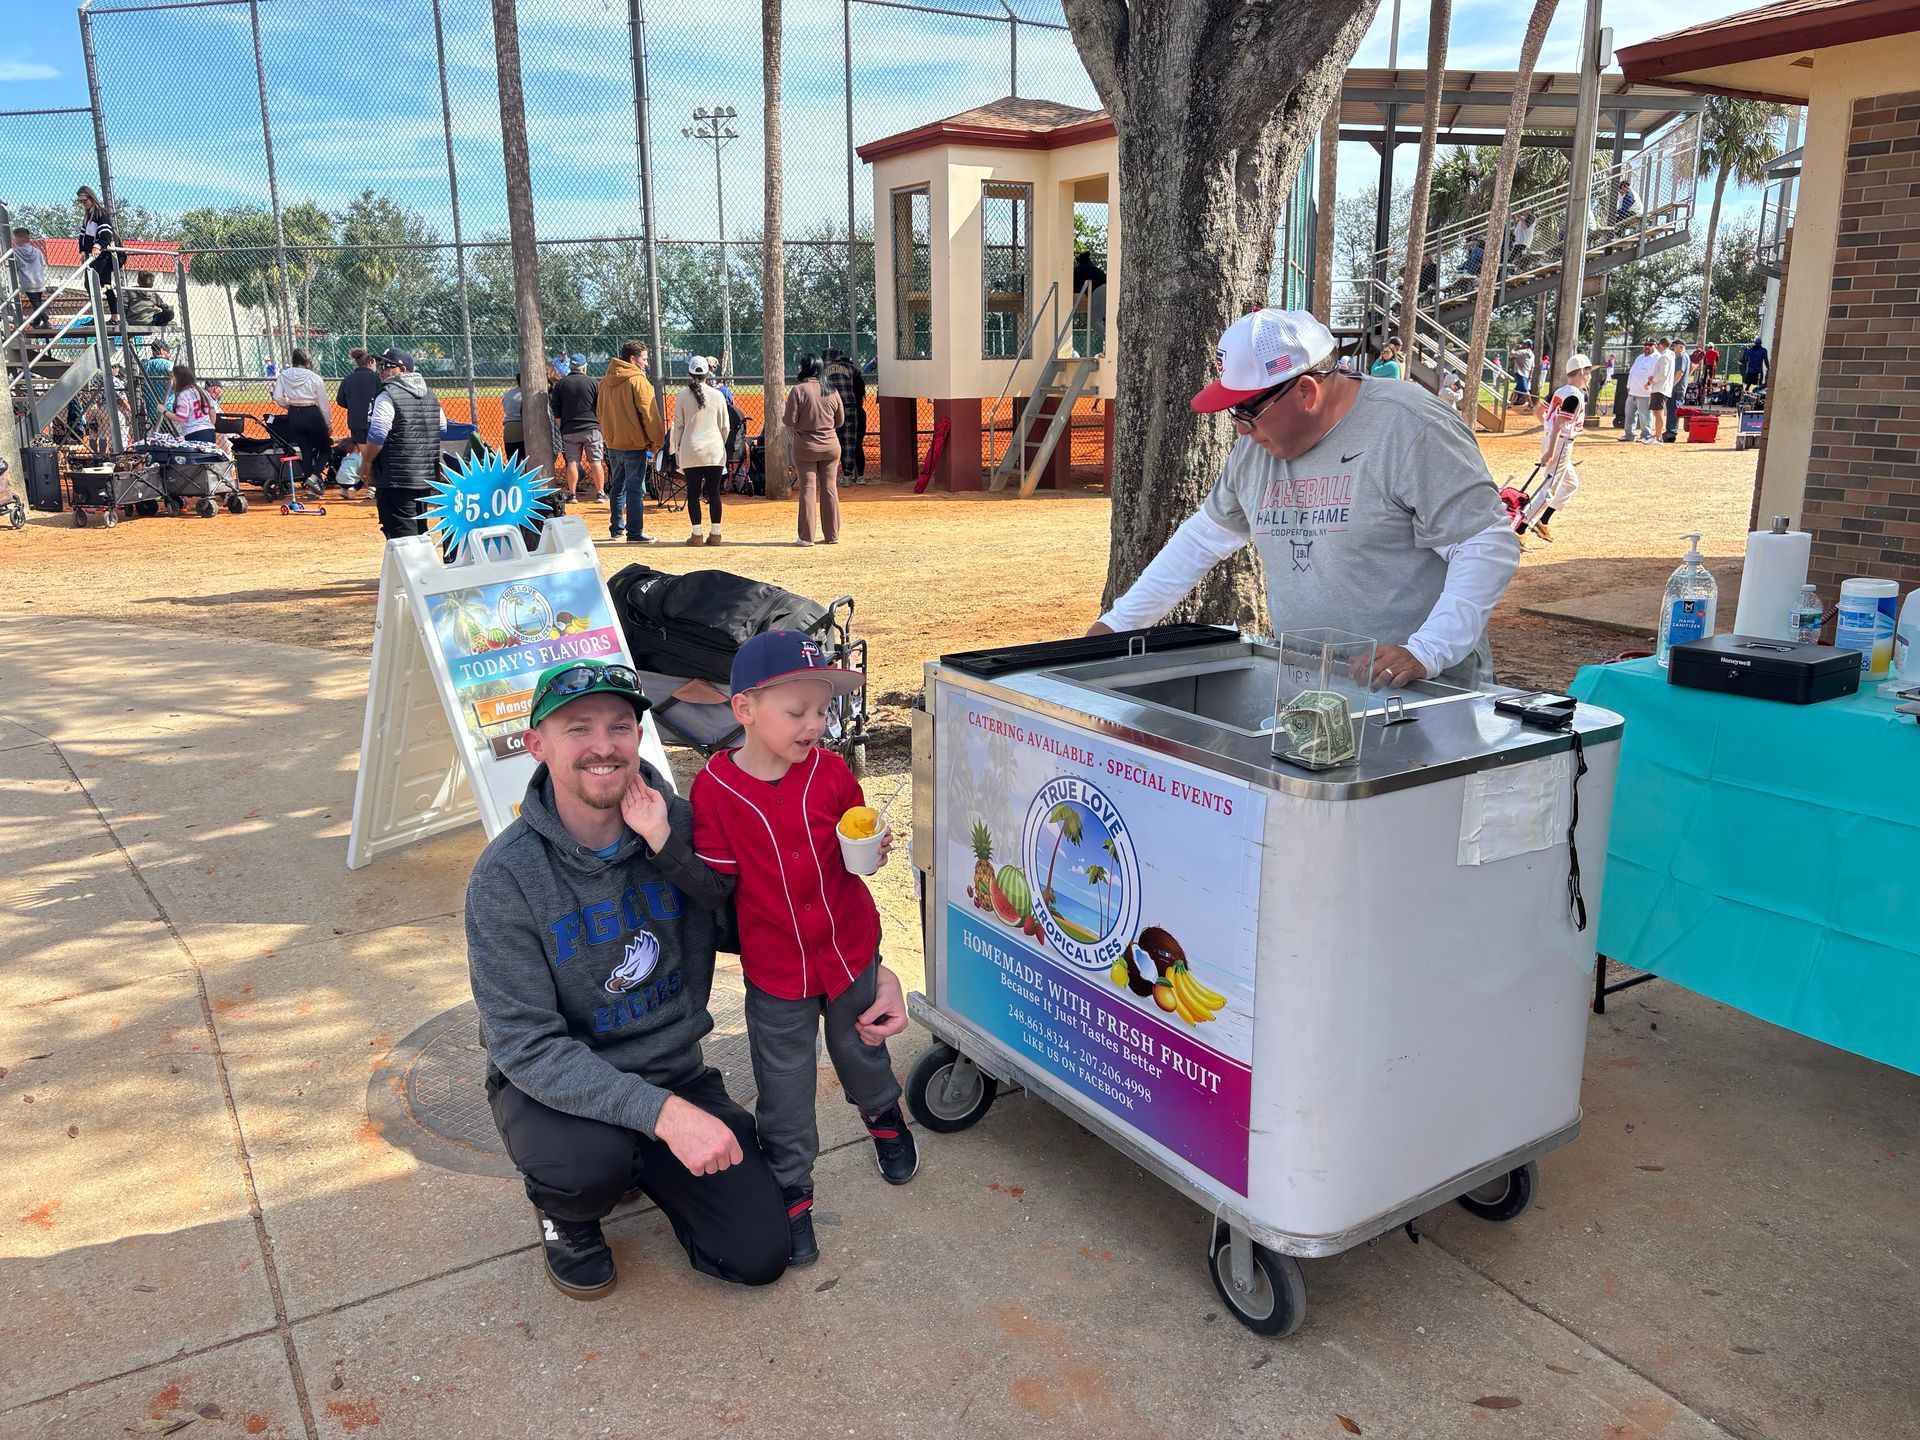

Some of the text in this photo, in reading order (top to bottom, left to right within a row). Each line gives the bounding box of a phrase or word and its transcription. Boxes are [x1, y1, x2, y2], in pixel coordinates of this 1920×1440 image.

[454, 485, 523, 523] $5.00
[1256, 511, 1288, 525] HALL
[1312, 508, 1349, 524] FAME
[501, 586, 537, 601] TRUE LOVE
[459, 634, 611, 681] TODAY'S FLAVORS
[513, 631, 543, 642] TROPICAL
[1720, 657, 1751, 667] Honeywell
[968, 711, 1024, 743] CATERING
[1027, 731, 1094, 768] AVAILABLE
[1107, 758, 1167, 793] SPECIAL
[1171, 780, 1233, 816] EVENTS
[1040, 781, 1123, 838] TRUE LOVE
[550, 880, 687, 967] FGCU
[1033, 898, 1123, 964] TROPICAL ICES
[592, 970, 681, 1033] EAGLES
[962, 929, 1221, 1094] HOMEMADE WITH FRESH FRUIT
[1000, 972, 1163, 1080] Because It Just Tastes Better
[1008, 1003, 1070, 1053] 248.863.8324
[1079, 1050, 1152, 1104] 207.206.4998
[1023, 1031, 1135, 1111] LIKE US ON FACEBOOK
